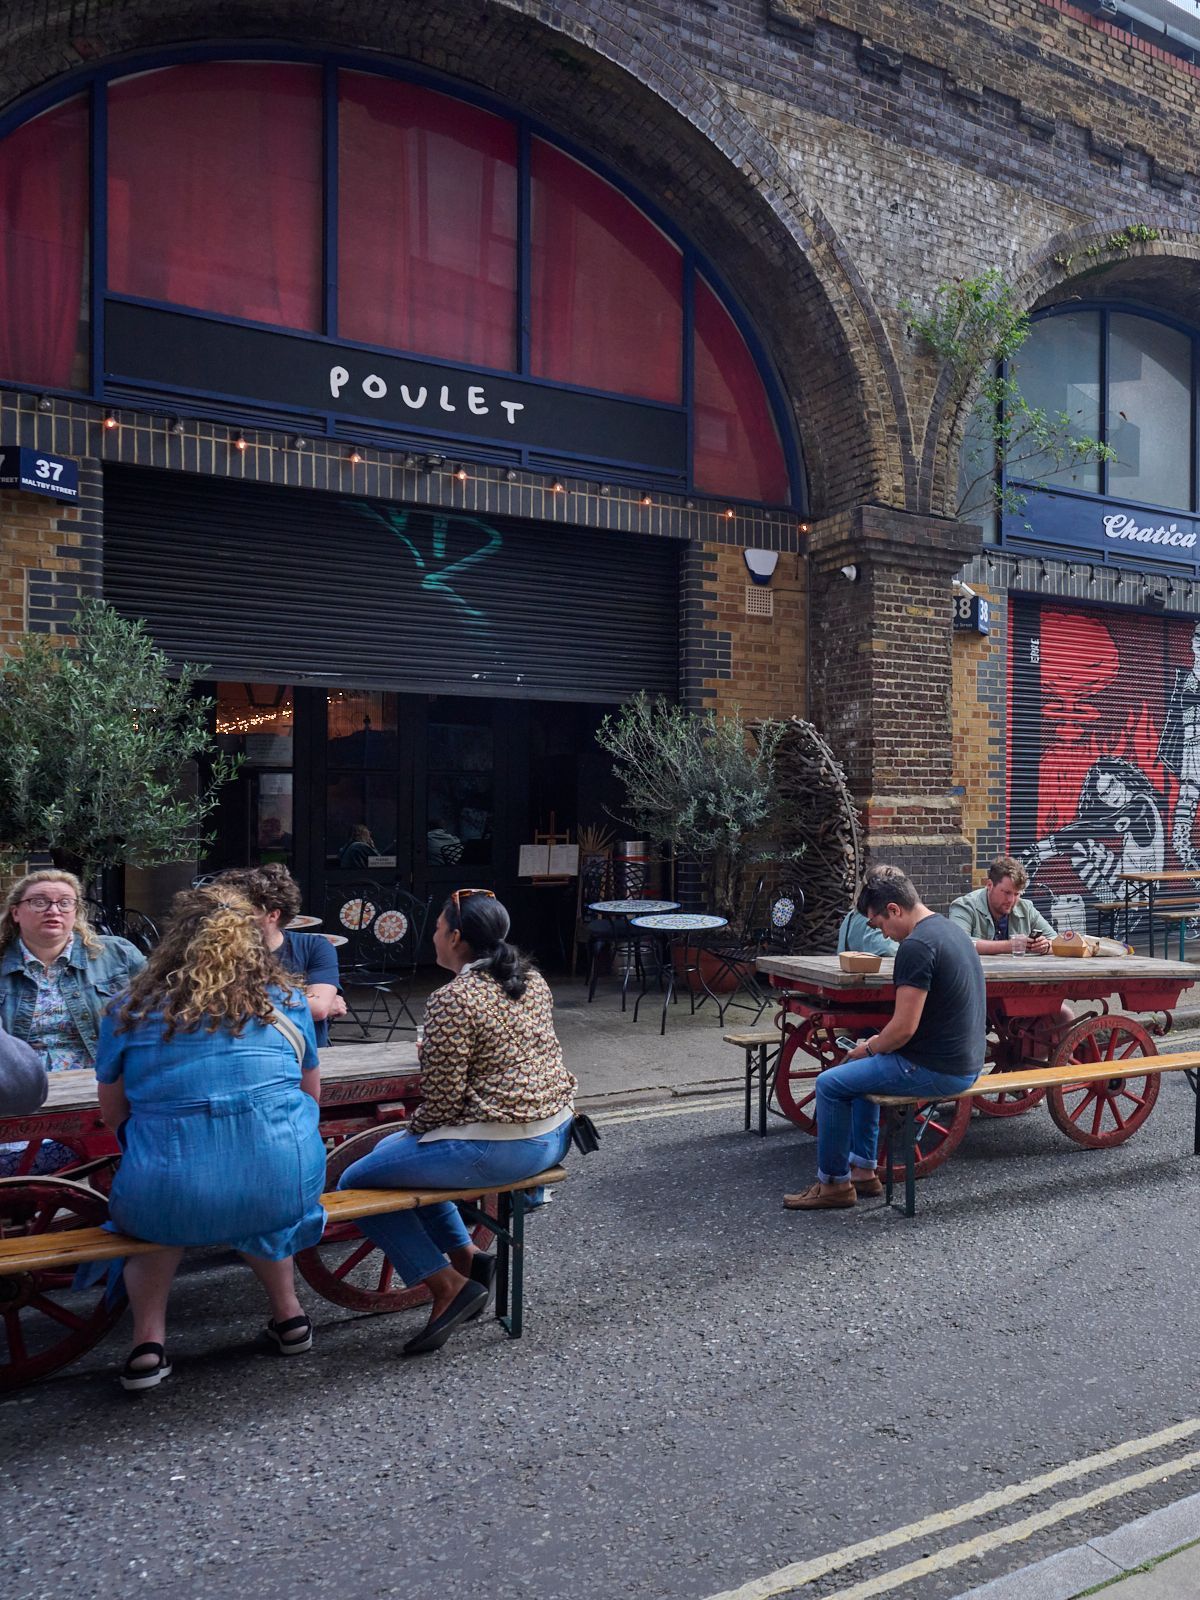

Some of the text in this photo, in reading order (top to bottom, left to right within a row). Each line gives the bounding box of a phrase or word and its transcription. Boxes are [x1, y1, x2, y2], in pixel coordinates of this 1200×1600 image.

[329, 365, 525, 425] POULET
[35, 459, 64, 481] 37
[21, 477, 77, 496] MALTBY STREET
[1103, 514, 1197, 548] Chatica
[980, 599, 988, 622] 38
